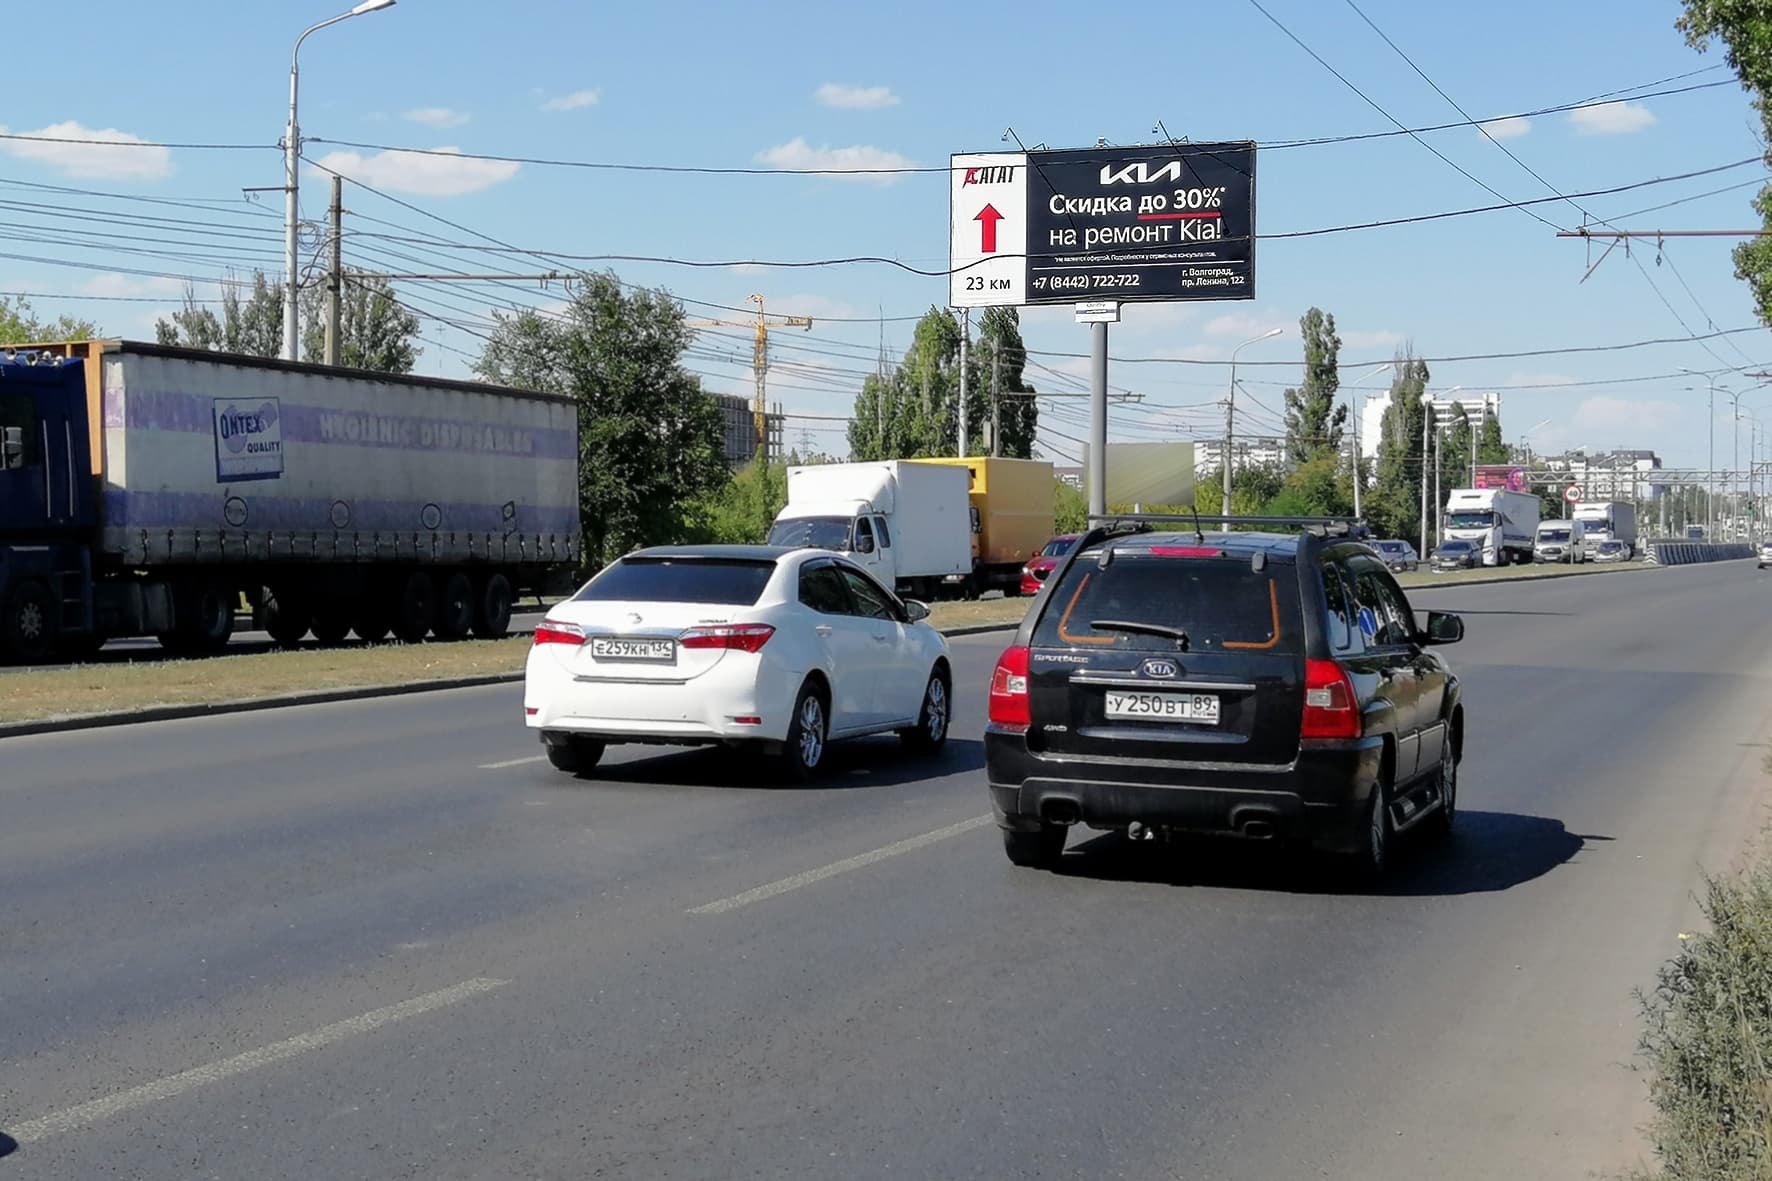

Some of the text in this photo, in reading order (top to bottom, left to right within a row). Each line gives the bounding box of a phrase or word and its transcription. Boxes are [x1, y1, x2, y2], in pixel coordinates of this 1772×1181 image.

[1049, 194, 1132, 216] Скидка
[1138, 192, 1167, 212] до
[1049, 217, 1222, 249] на ремонт Kia!
[966, 277, 1011, 291] 23 км
[1032, 274, 1140, 290] +7 (8442) 722-722
[1182, 279, 1194, 288] пр.
[1230, 276, 1245, 285] 122
[220, 413, 262, 439] ONTEX
[247, 441, 280, 453] QUALITY
[1568, 489, 1577, 497] 40
[1149, 664, 1171, 675] KIA
[1194, 696, 1212, 711] 89
